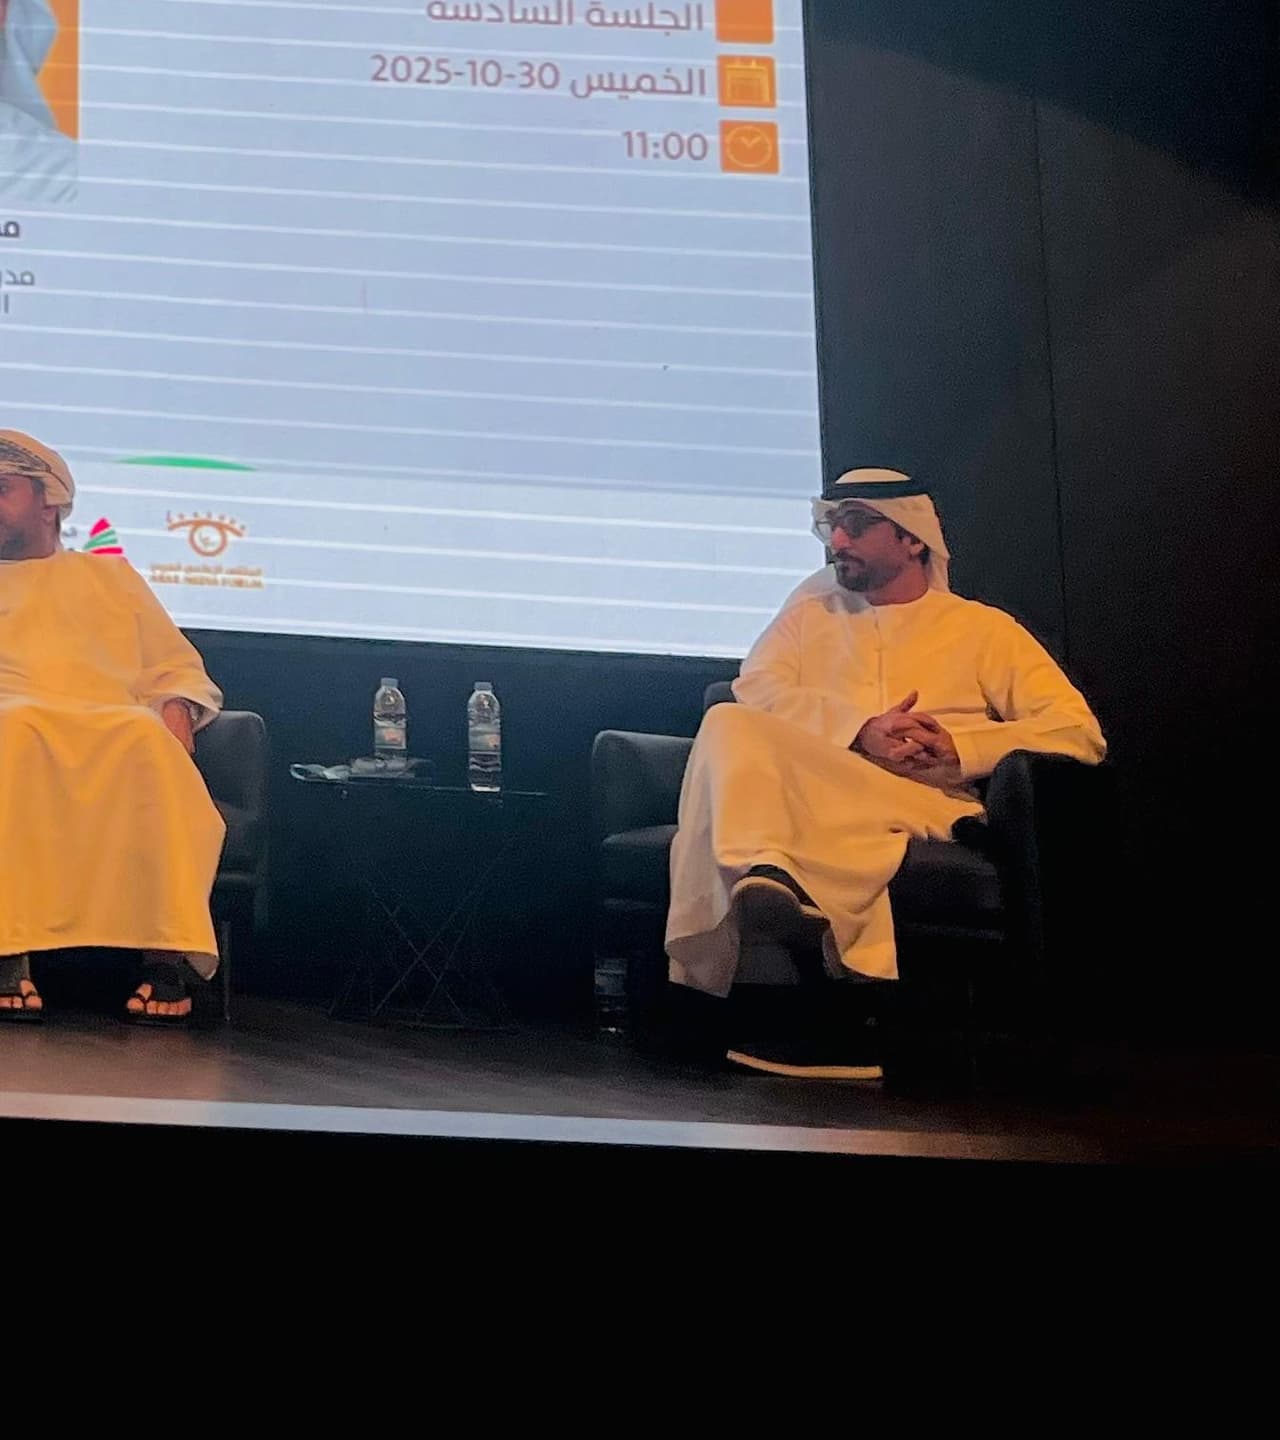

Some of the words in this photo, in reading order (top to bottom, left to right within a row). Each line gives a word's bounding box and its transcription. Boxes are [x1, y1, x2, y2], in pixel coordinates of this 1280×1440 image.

[585, 0, 704, 37] الجلسة
[570, 66, 707, 100] الخميس
[622, 130, 709, 161] 11:00
